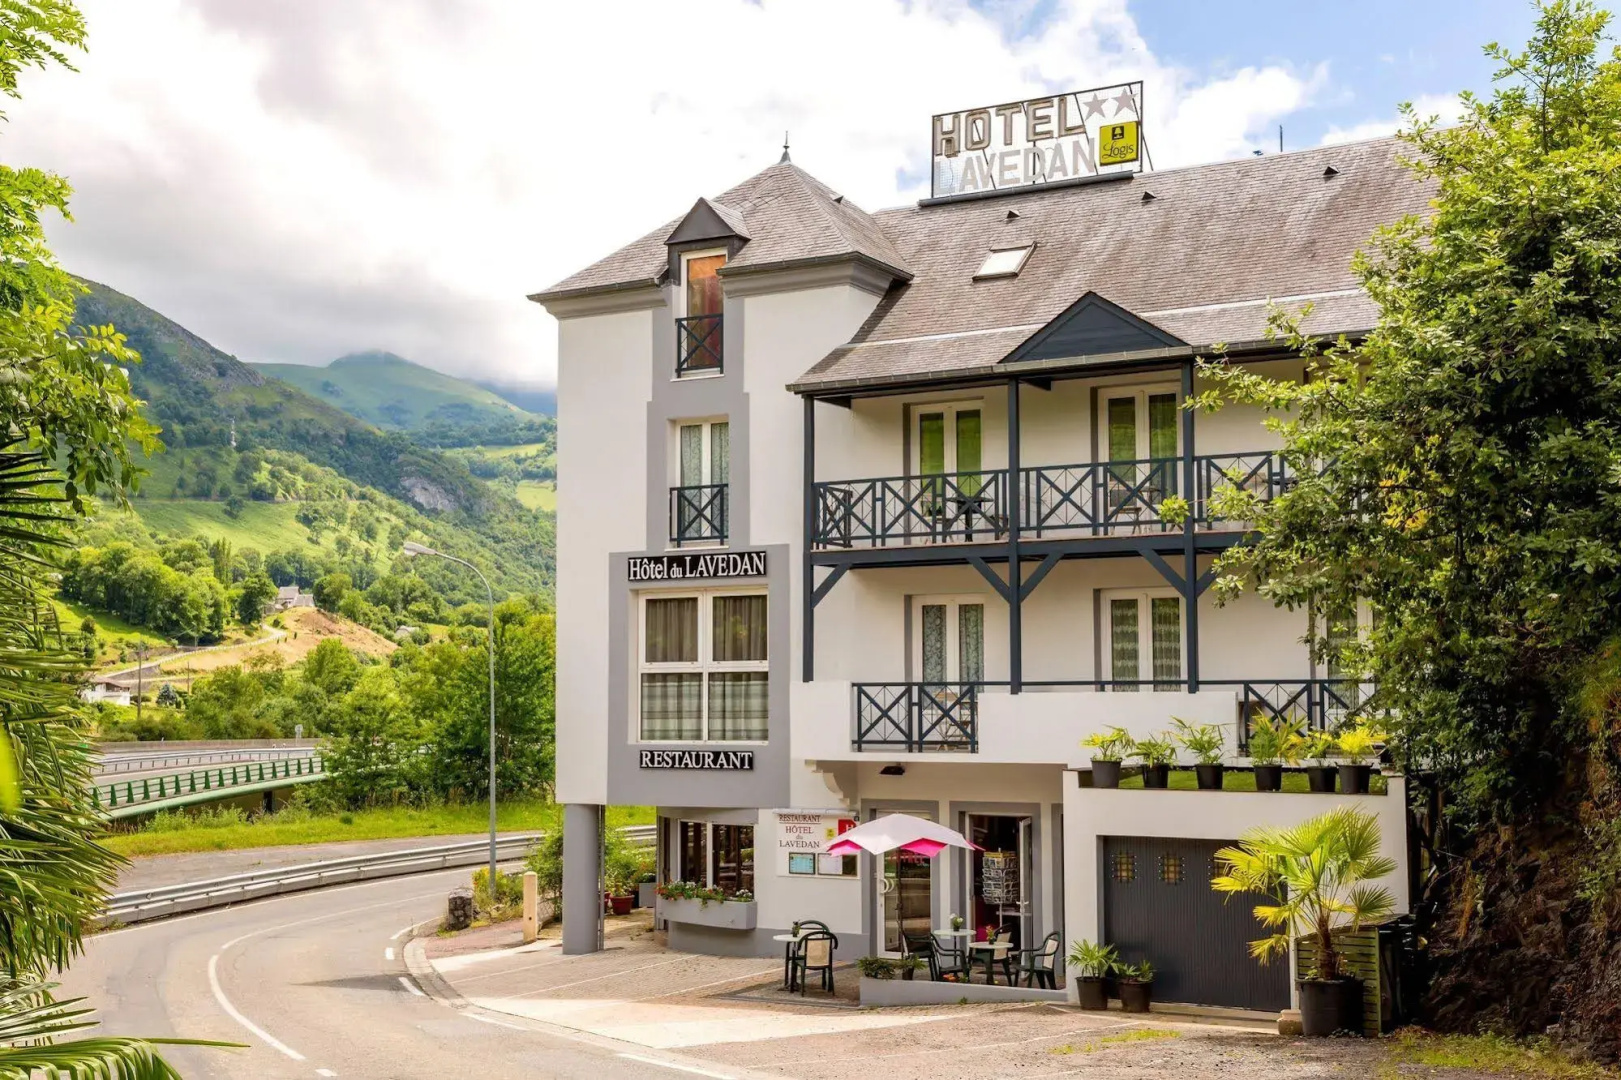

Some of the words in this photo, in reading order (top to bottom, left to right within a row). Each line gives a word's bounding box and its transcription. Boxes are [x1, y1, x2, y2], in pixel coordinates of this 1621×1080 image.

[934, 96, 1086, 157] HOTEL
[1102, 141, 1134, 159] Logis
[934, 138, 1095, 195] LAVEDAN
[629, 557, 668, 580] Hôtel
[670, 563, 683, 578] du
[685, 553, 765, 577] LAVEDAN
[641, 751, 752, 769] RESTAURANT
[779, 814, 820, 822] RESTAURANT
[785, 825, 813, 834] HÔTEL
[779, 840, 820, 848] LAVEDAN
